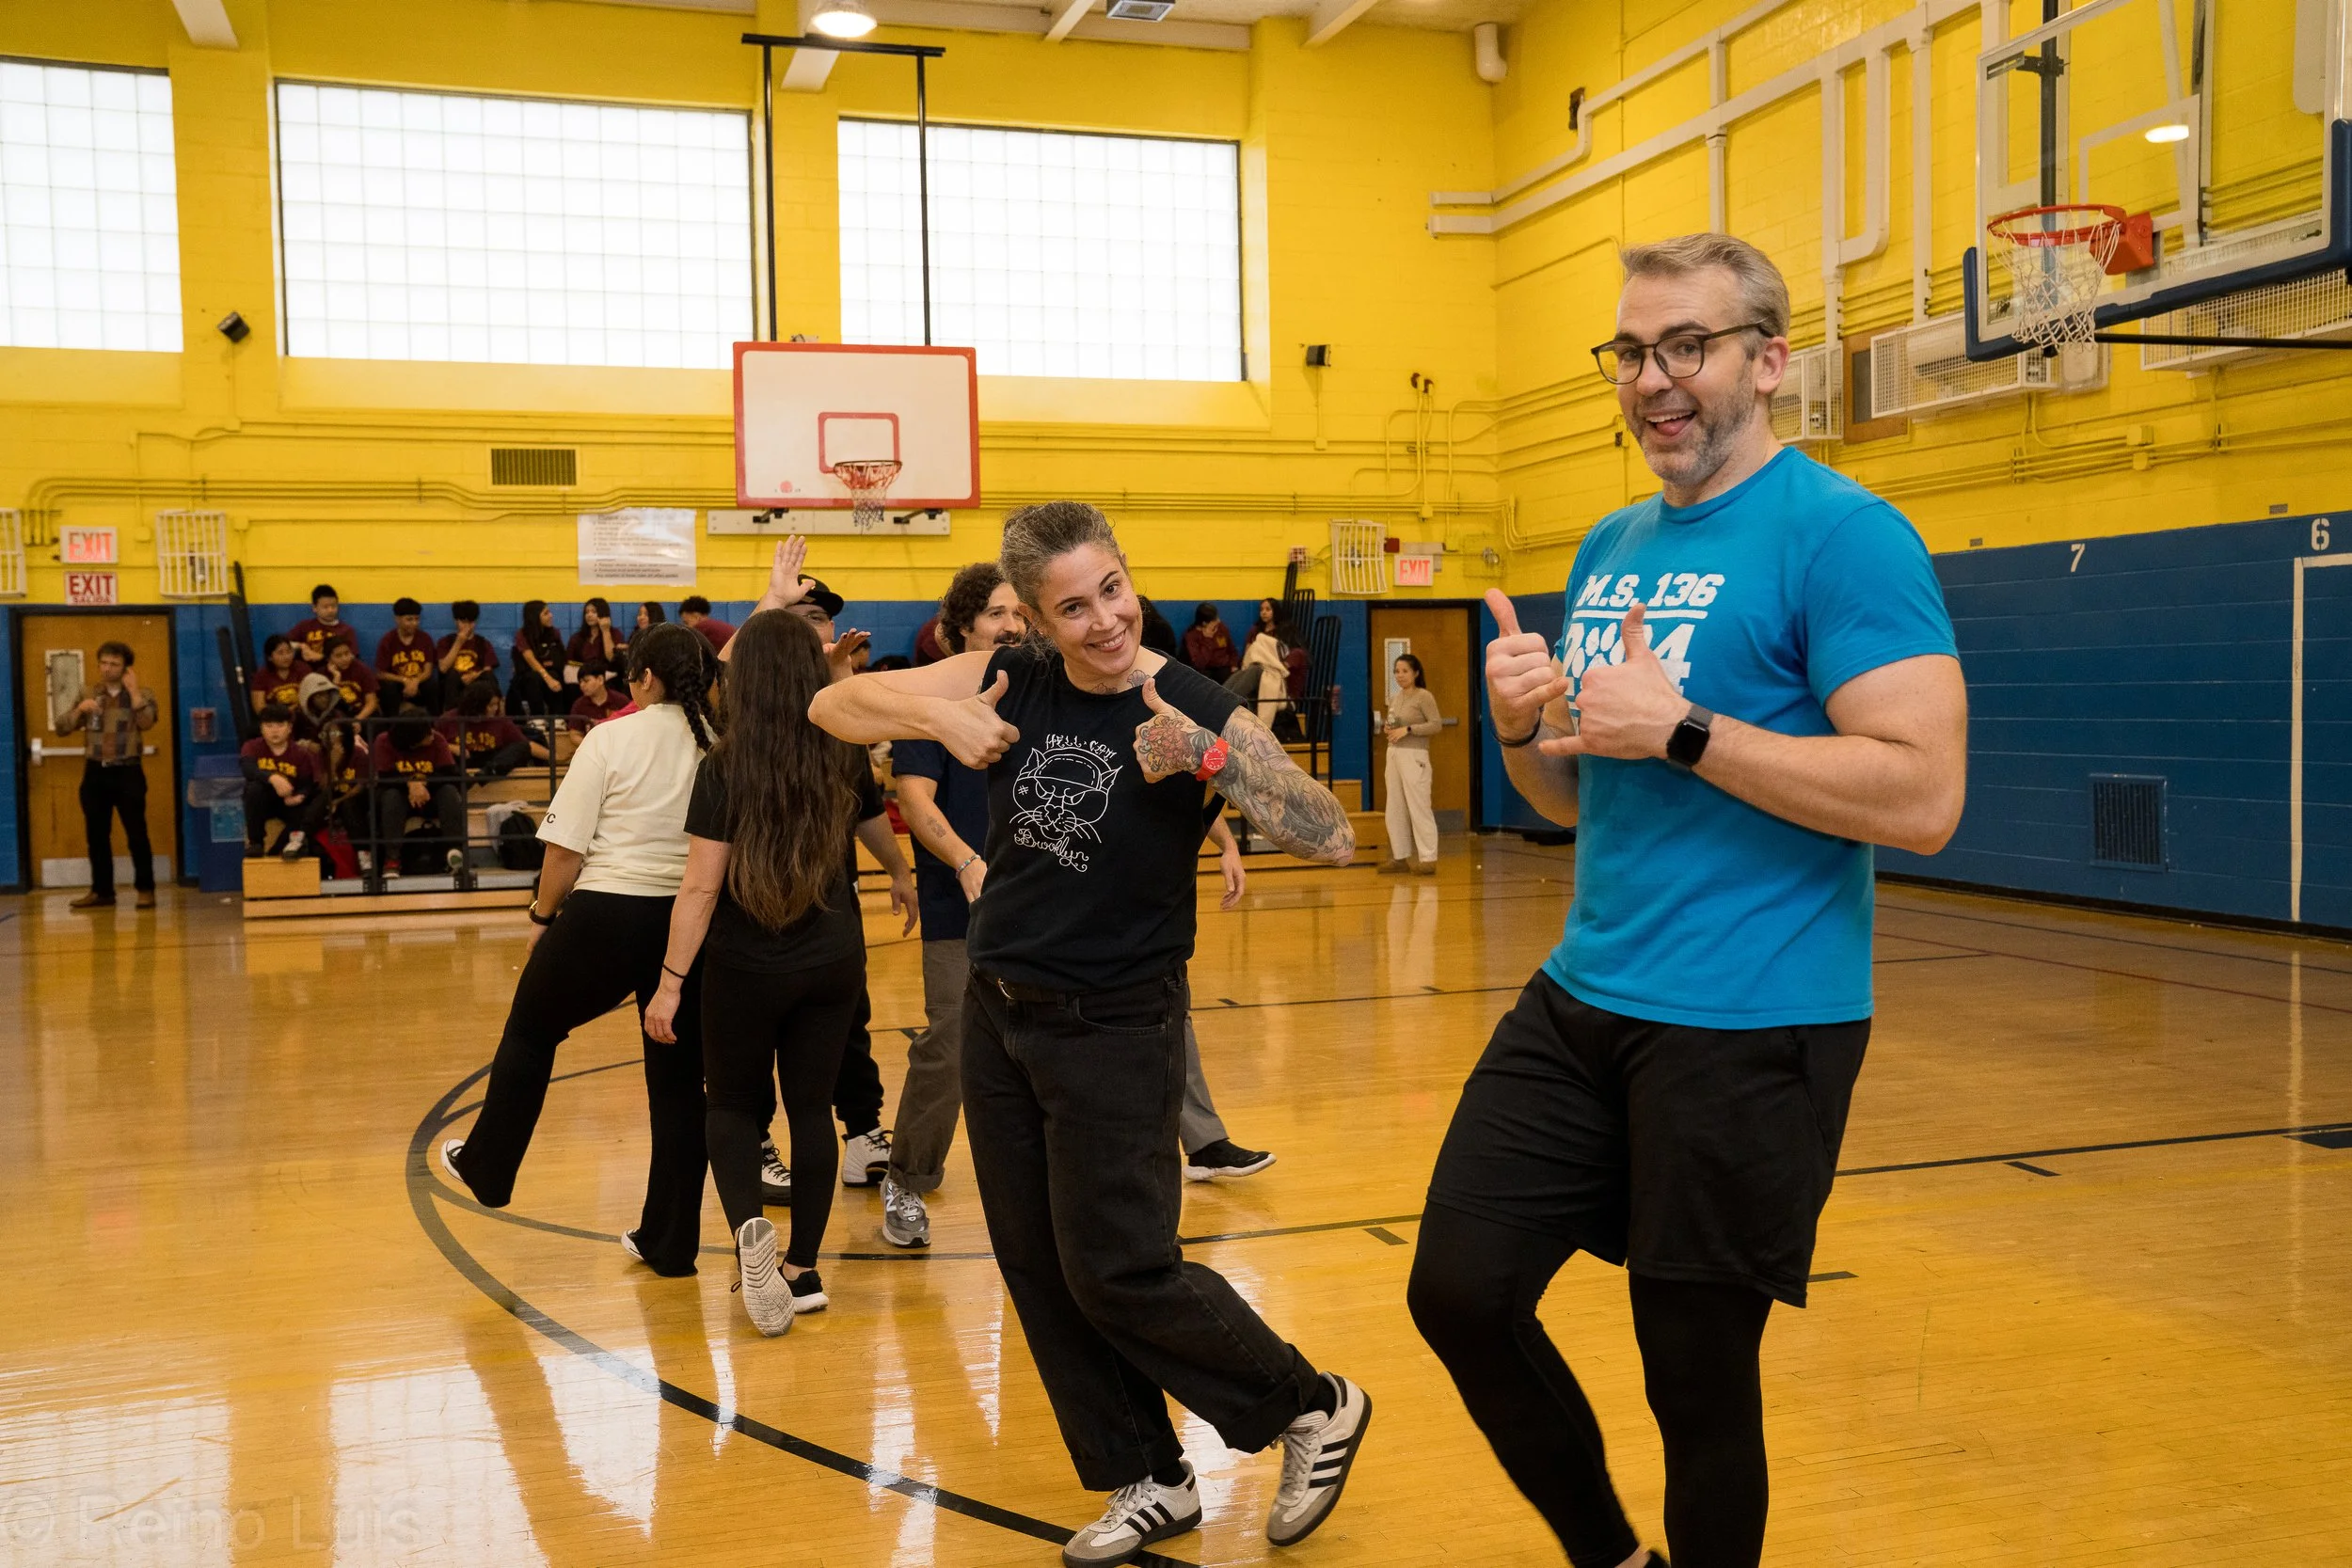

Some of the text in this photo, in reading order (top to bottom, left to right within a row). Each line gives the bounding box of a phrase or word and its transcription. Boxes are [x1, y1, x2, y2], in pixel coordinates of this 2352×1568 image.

[68, 532, 113, 562] EXIT
[2311, 518, 2330, 550] 6
[1399, 560, 1430, 584] EXIT
[2071, 544, 2085, 572] 7
[70, 575, 113, 595] EXIT
[1577, 572, 1725, 608] M.S. 136
